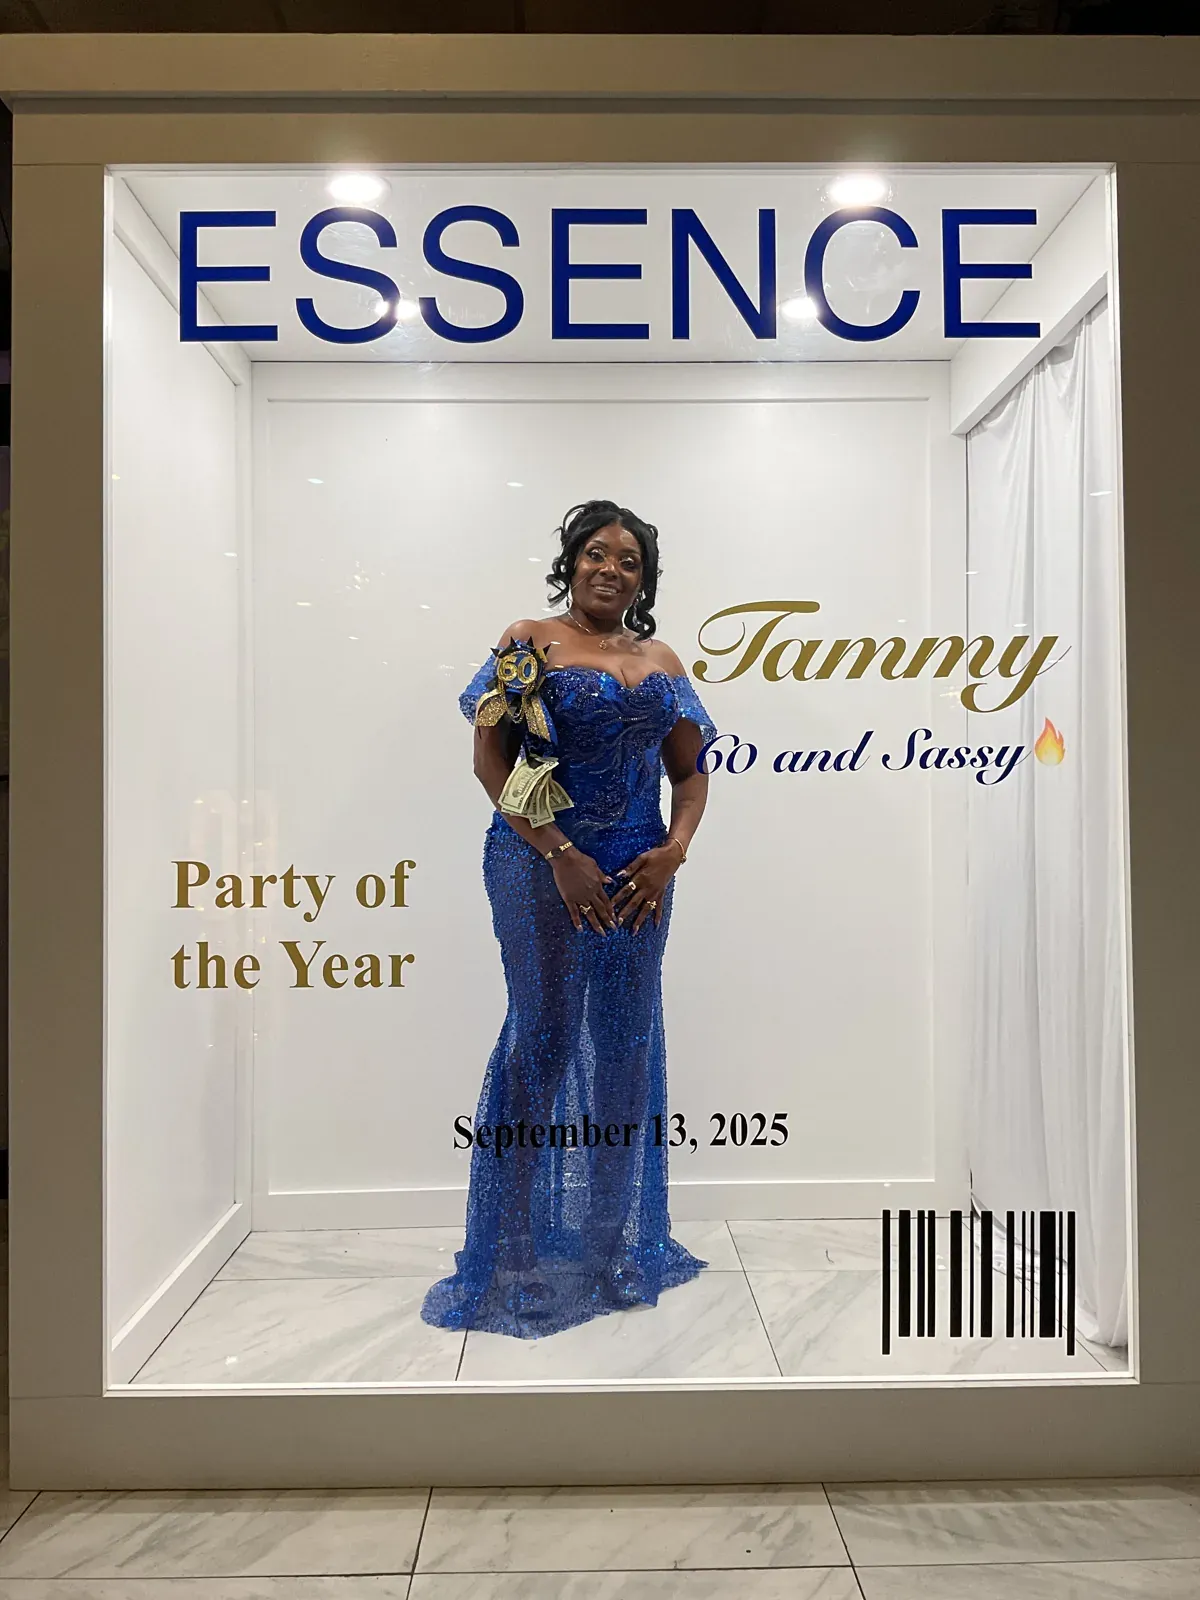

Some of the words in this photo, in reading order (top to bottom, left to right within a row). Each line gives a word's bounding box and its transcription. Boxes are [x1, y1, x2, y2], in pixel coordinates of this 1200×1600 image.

[179, 205, 1042, 345] ESSENCE
[500, 654, 539, 685] 60
[692, 600, 1073, 714] Tammy
[695, 733, 759, 775] 60
[772, 730, 876, 773] and
[880, 727, 1031, 785] Sassy
[170, 860, 337, 923] Party
[355, 859, 417, 909] of
[170, 940, 261, 990] the
[278, 940, 416, 989] Year
[453, 1114, 639, 1159] September
[651, 1112, 699, 1155] 13,
[708, 1112, 790, 1147] 2025
